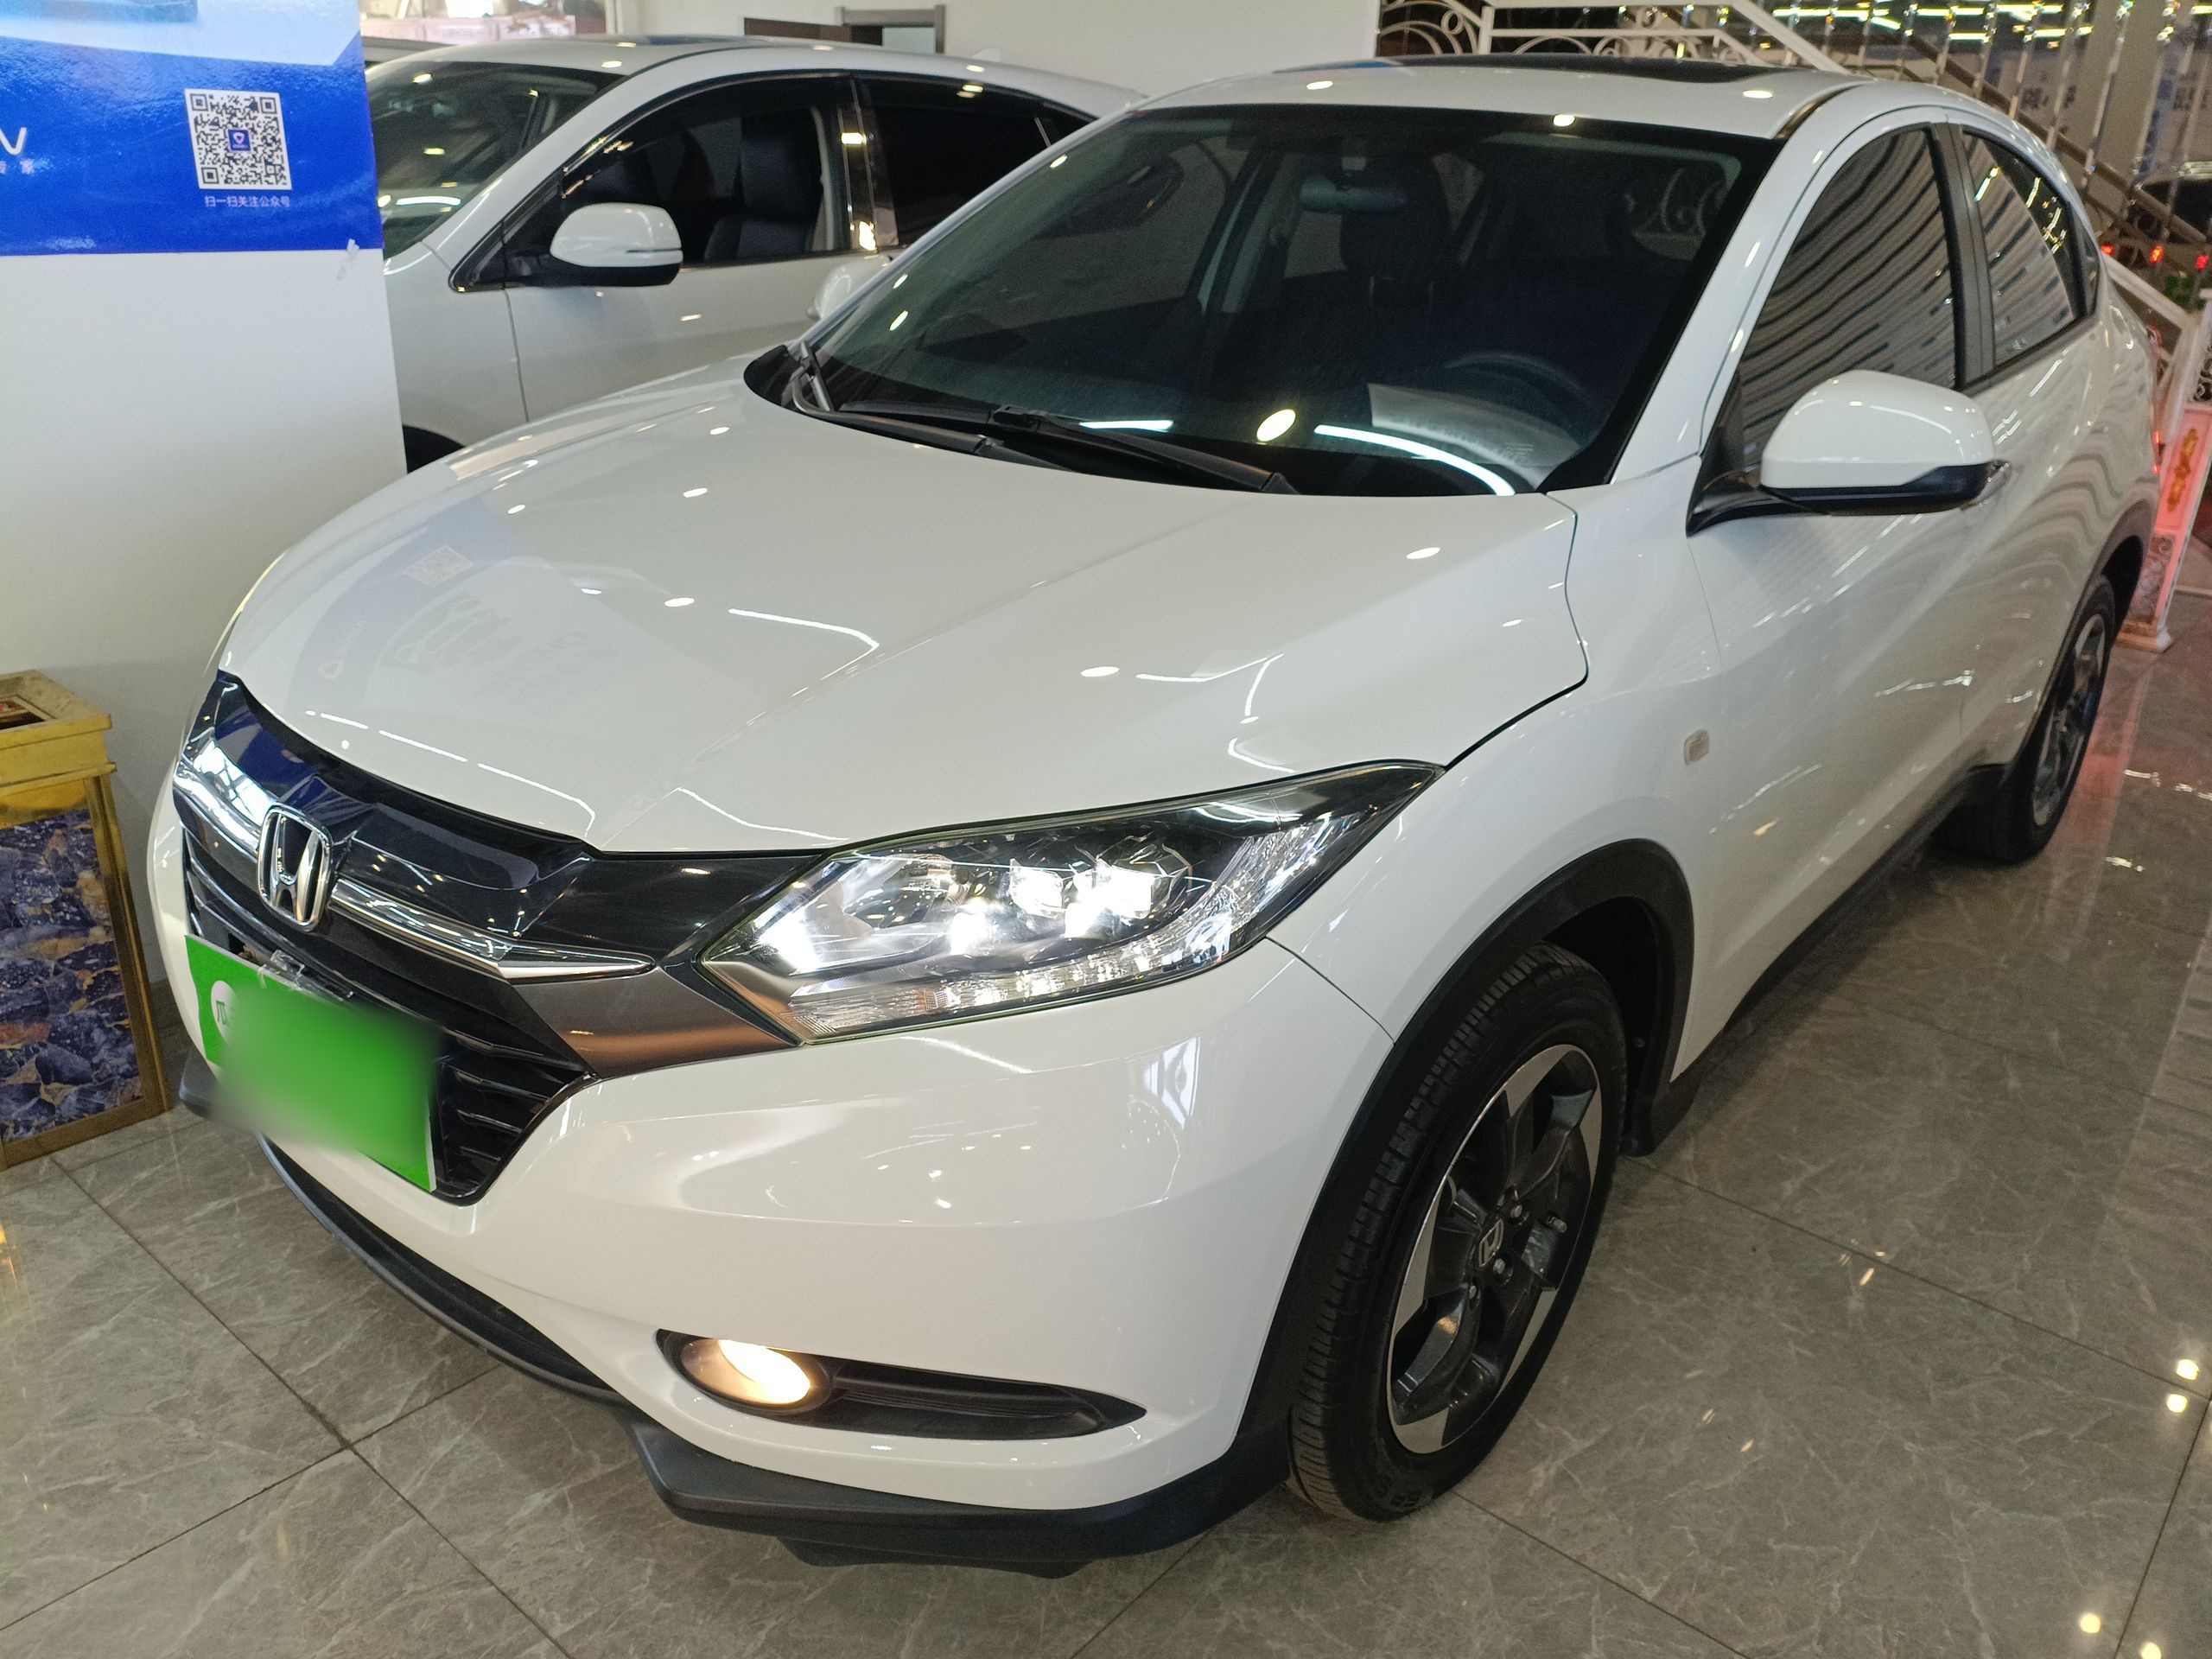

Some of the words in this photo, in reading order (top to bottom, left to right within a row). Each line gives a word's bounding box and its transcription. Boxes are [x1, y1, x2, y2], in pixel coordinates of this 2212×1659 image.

[204, 195, 290, 208] 扫一扫关注公众号
[267, 811, 322, 924] H
